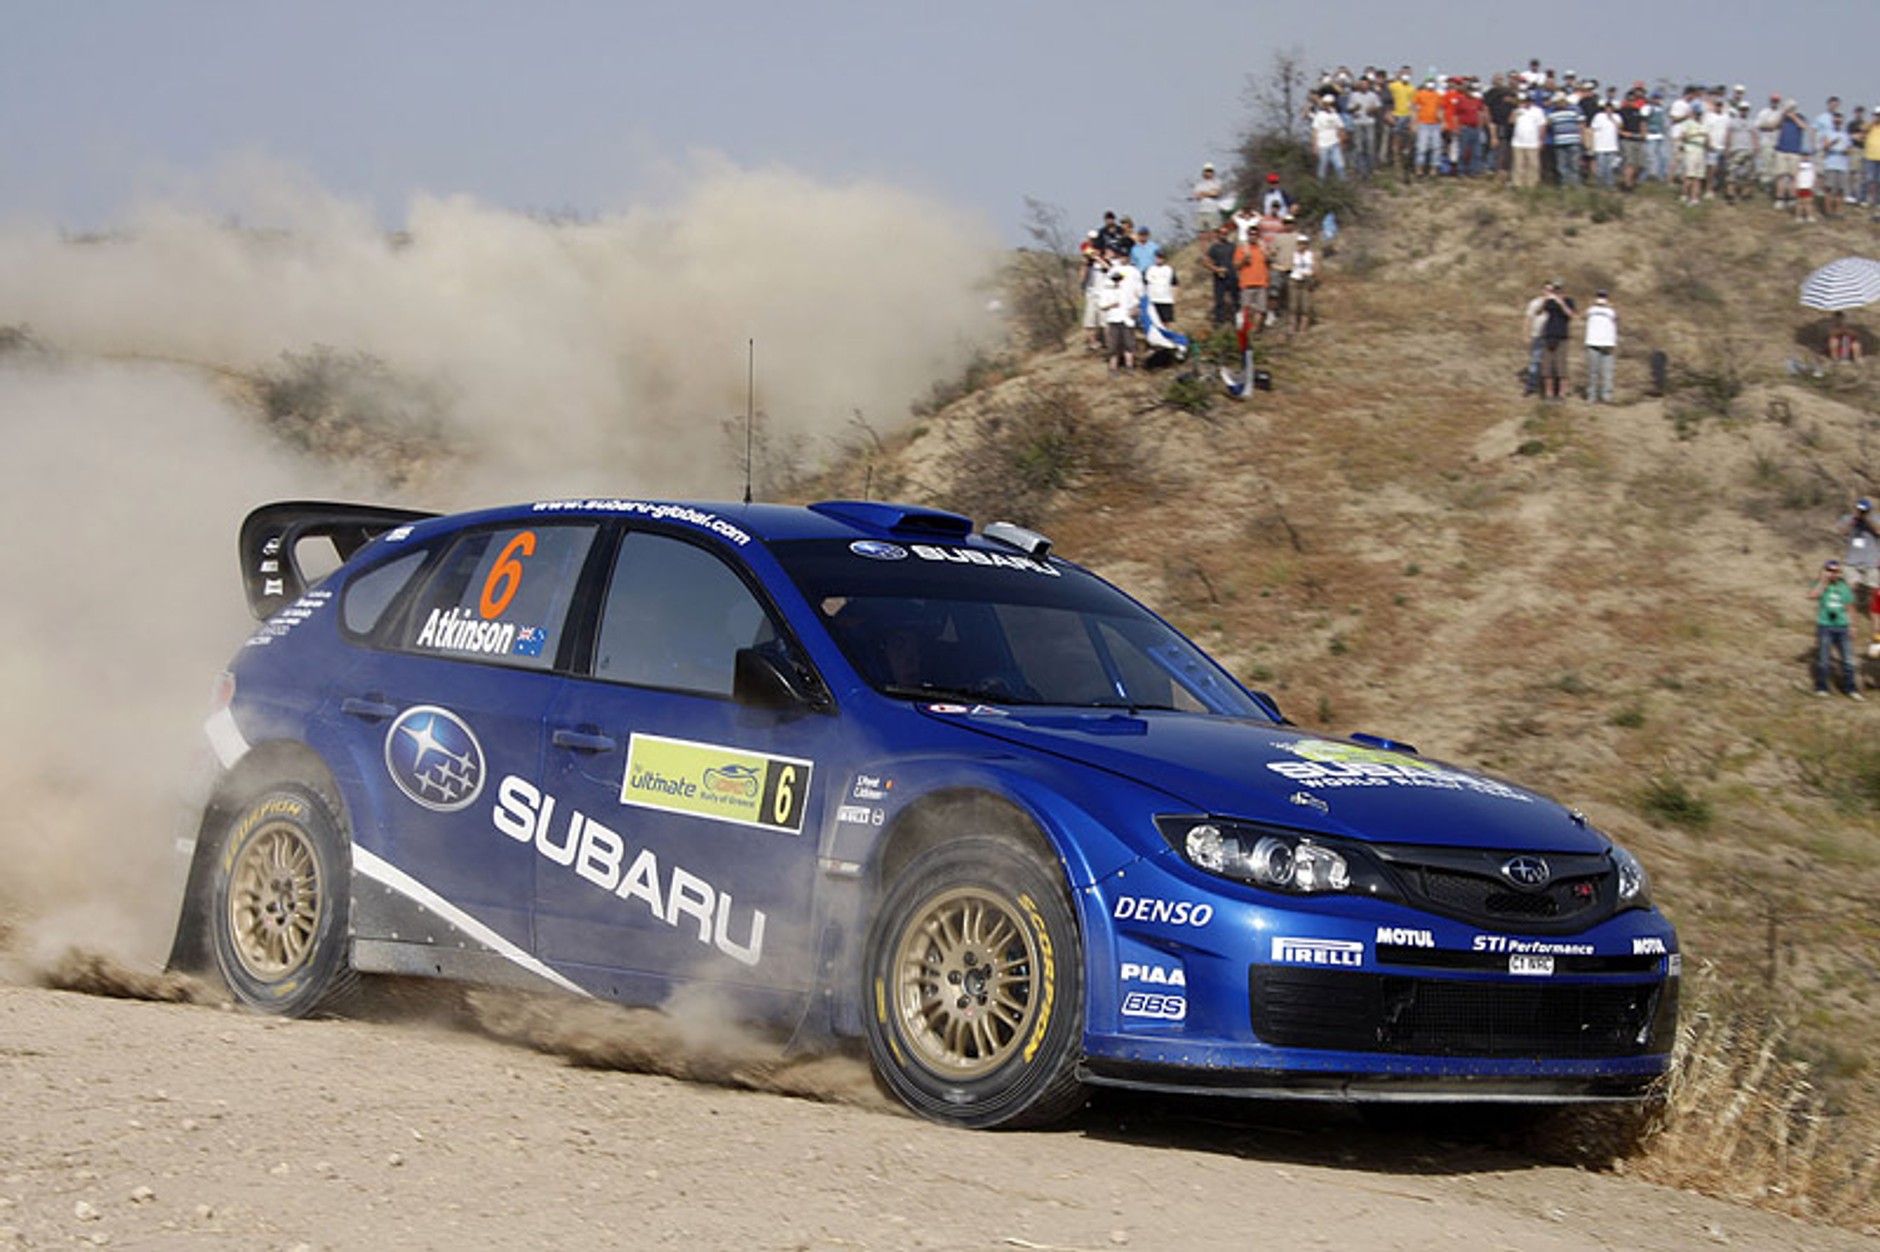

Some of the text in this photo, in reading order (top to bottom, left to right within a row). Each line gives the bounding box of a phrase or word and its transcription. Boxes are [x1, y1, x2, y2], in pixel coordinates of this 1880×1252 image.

[533, 499, 752, 547] www.subaru-global.com
[479, 531, 537, 620] 6
[910, 545, 1061, 577] SUBARU
[416, 607, 515, 654] Atkinson
[631, 770, 697, 798] ultimate
[774, 765, 796, 824] 6
[493, 775, 766, 966] SUBARU
[1114, 896, 1213, 927] DENSO
[1271, 936, 1364, 967] PIRELLI
[1376, 927, 1435, 948] MOTUL
[1473, 935, 1594, 955] STI Performance
[1121, 963, 1186, 986] PIAA
[1123, 993, 1185, 1018] BBS
